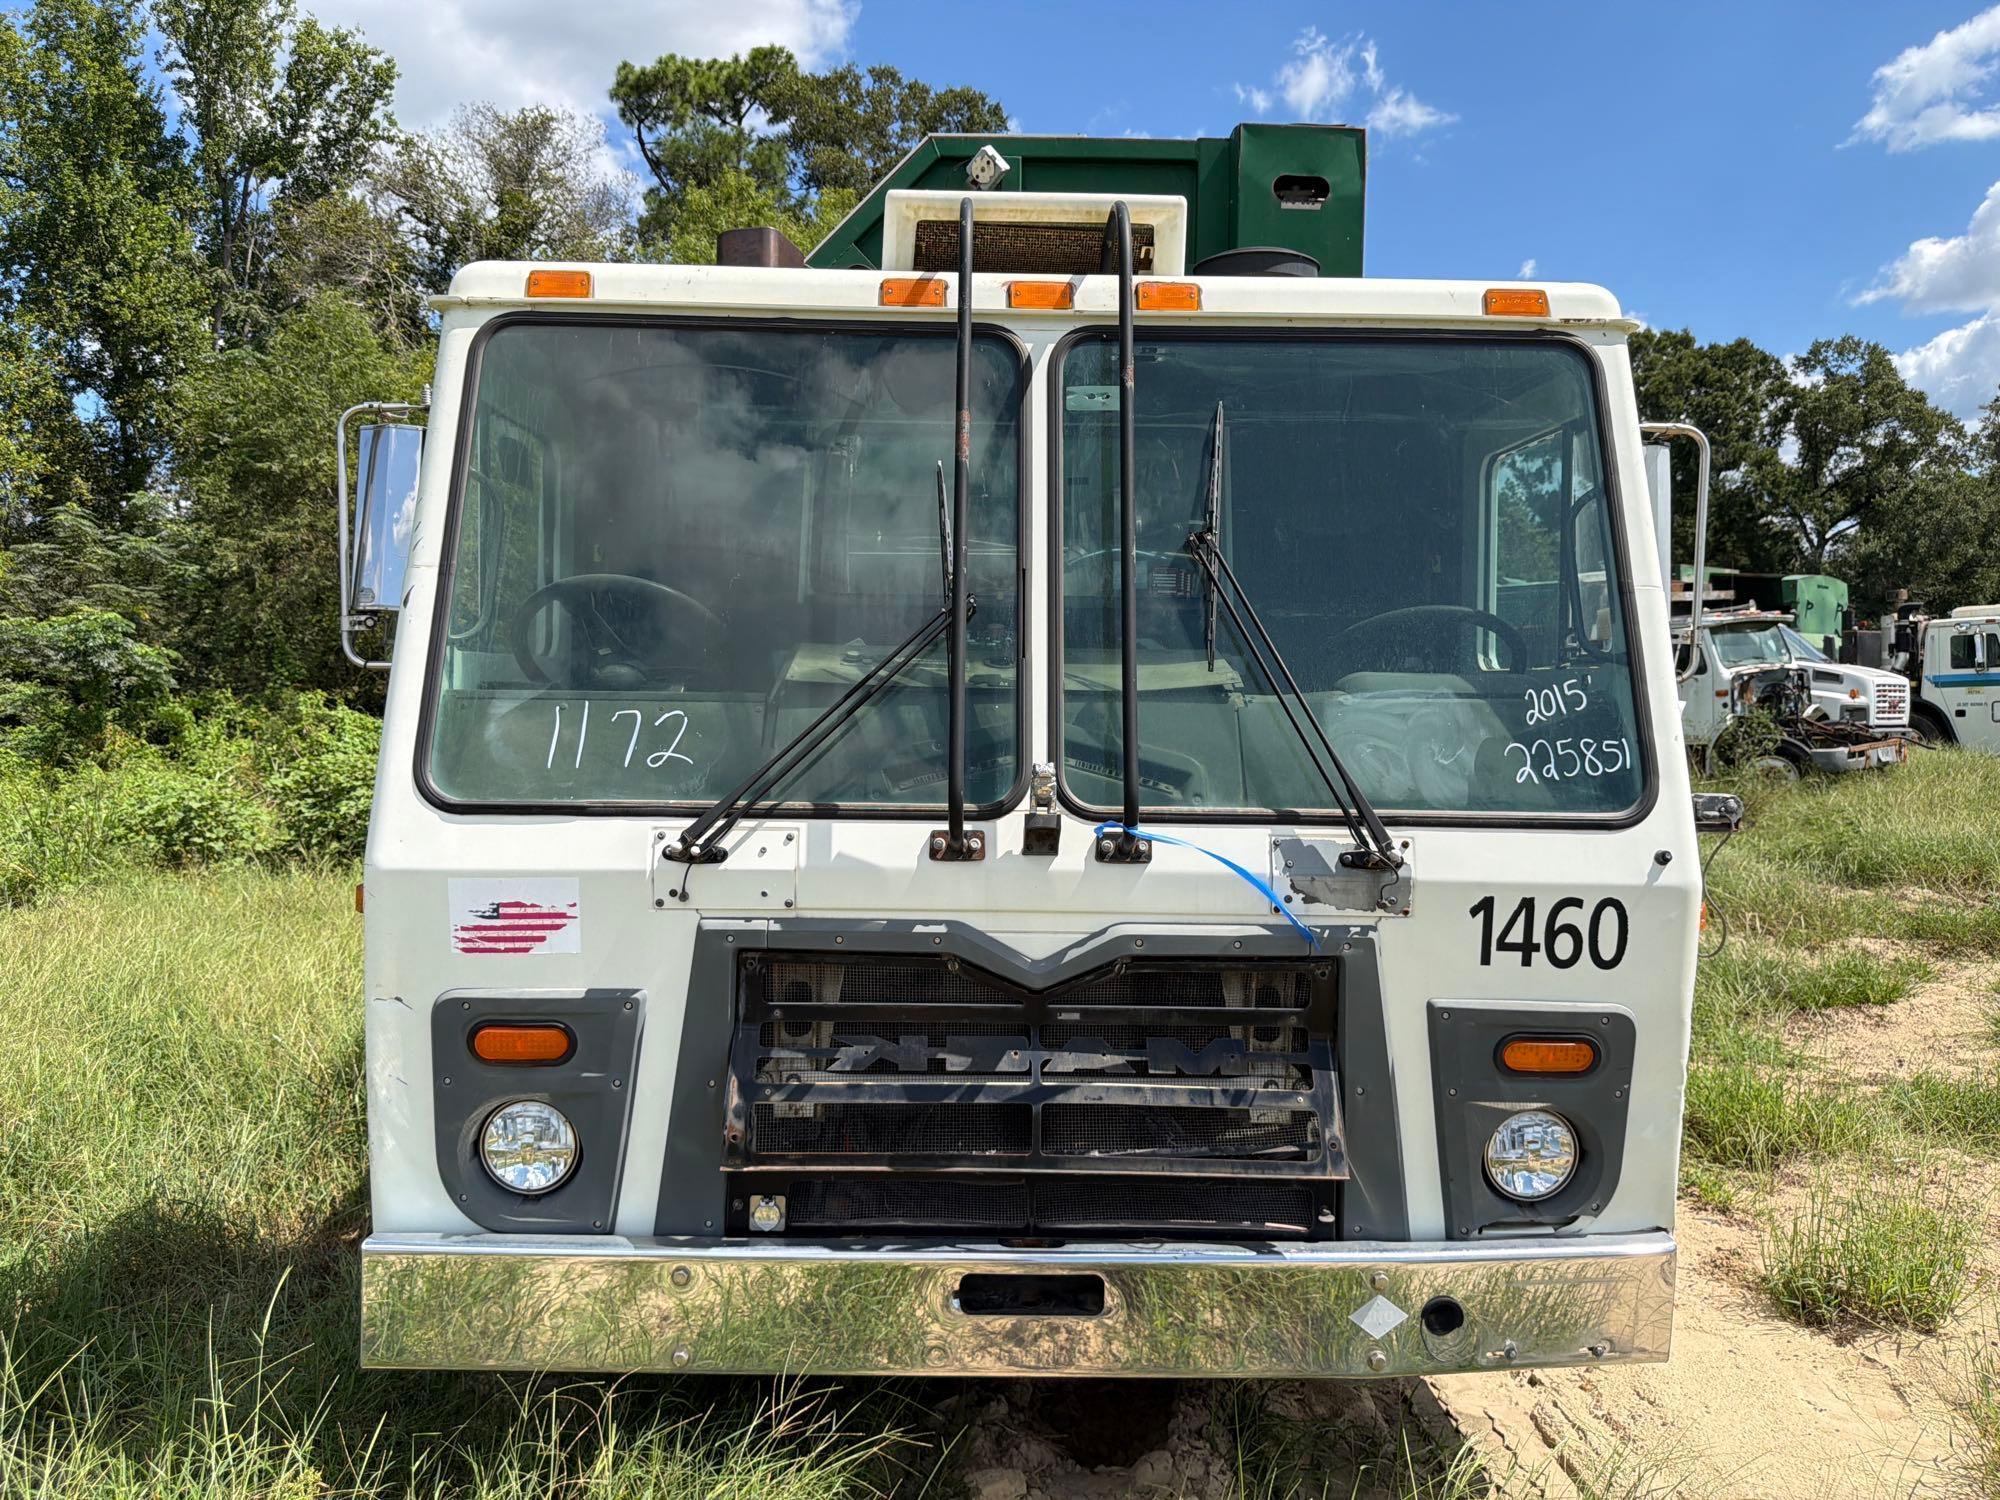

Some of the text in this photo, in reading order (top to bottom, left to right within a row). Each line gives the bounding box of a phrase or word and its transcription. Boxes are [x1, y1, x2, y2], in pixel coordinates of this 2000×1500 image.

[547, 700, 694, 769] 1172
[1503, 737, 1631, 784] 225851
[1468, 895, 1629, 970] 1460
